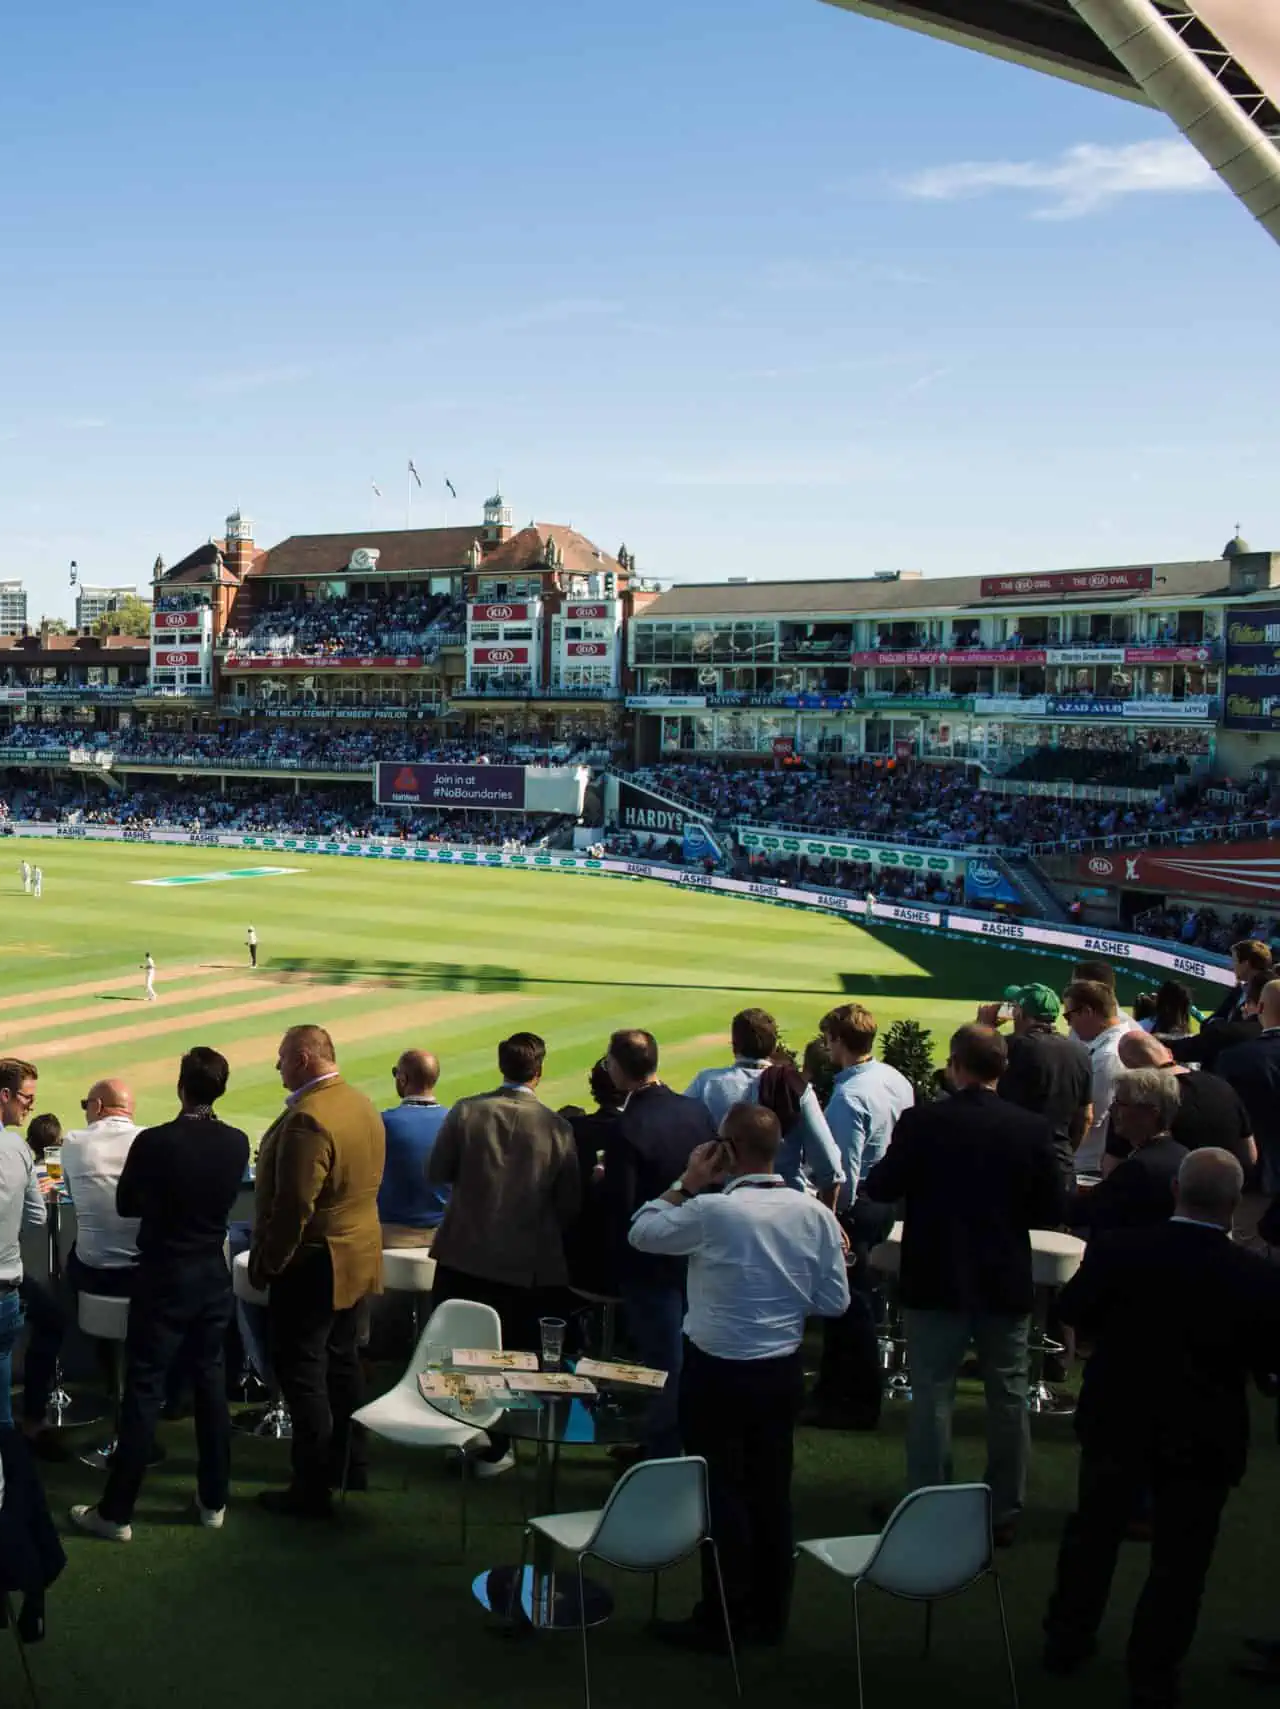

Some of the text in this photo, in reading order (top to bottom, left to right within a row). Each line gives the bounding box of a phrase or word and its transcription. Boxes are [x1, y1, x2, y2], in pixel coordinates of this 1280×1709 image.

[1110, 574, 1129, 584] OVAL
[489, 606, 510, 619] KIA
[577, 608, 596, 616] KIA
[167, 614, 186, 625] KIA
[577, 645, 596, 654] KIA
[168, 654, 186, 664] KIA
[490, 650, 512, 662] KIA
[1056, 703, 1089, 712] AZAD
[375, 711, 409, 719] PAVILION
[433, 773, 476, 785] Join in at
[392, 792, 420, 801] NatWest
[433, 787, 513, 800] #NoBoundaries
[626, 808, 683, 832] HARDYS
[123, 831, 152, 840] #ASHES
[190, 833, 220, 843] #ASHES
[817, 896, 848, 909] #ASHES
[893, 907, 931, 923] #ASHES
[982, 922, 1024, 938] #ASHES
[1084, 939, 1131, 956] #ASHES
[1173, 957, 1206, 976] #ASHES
